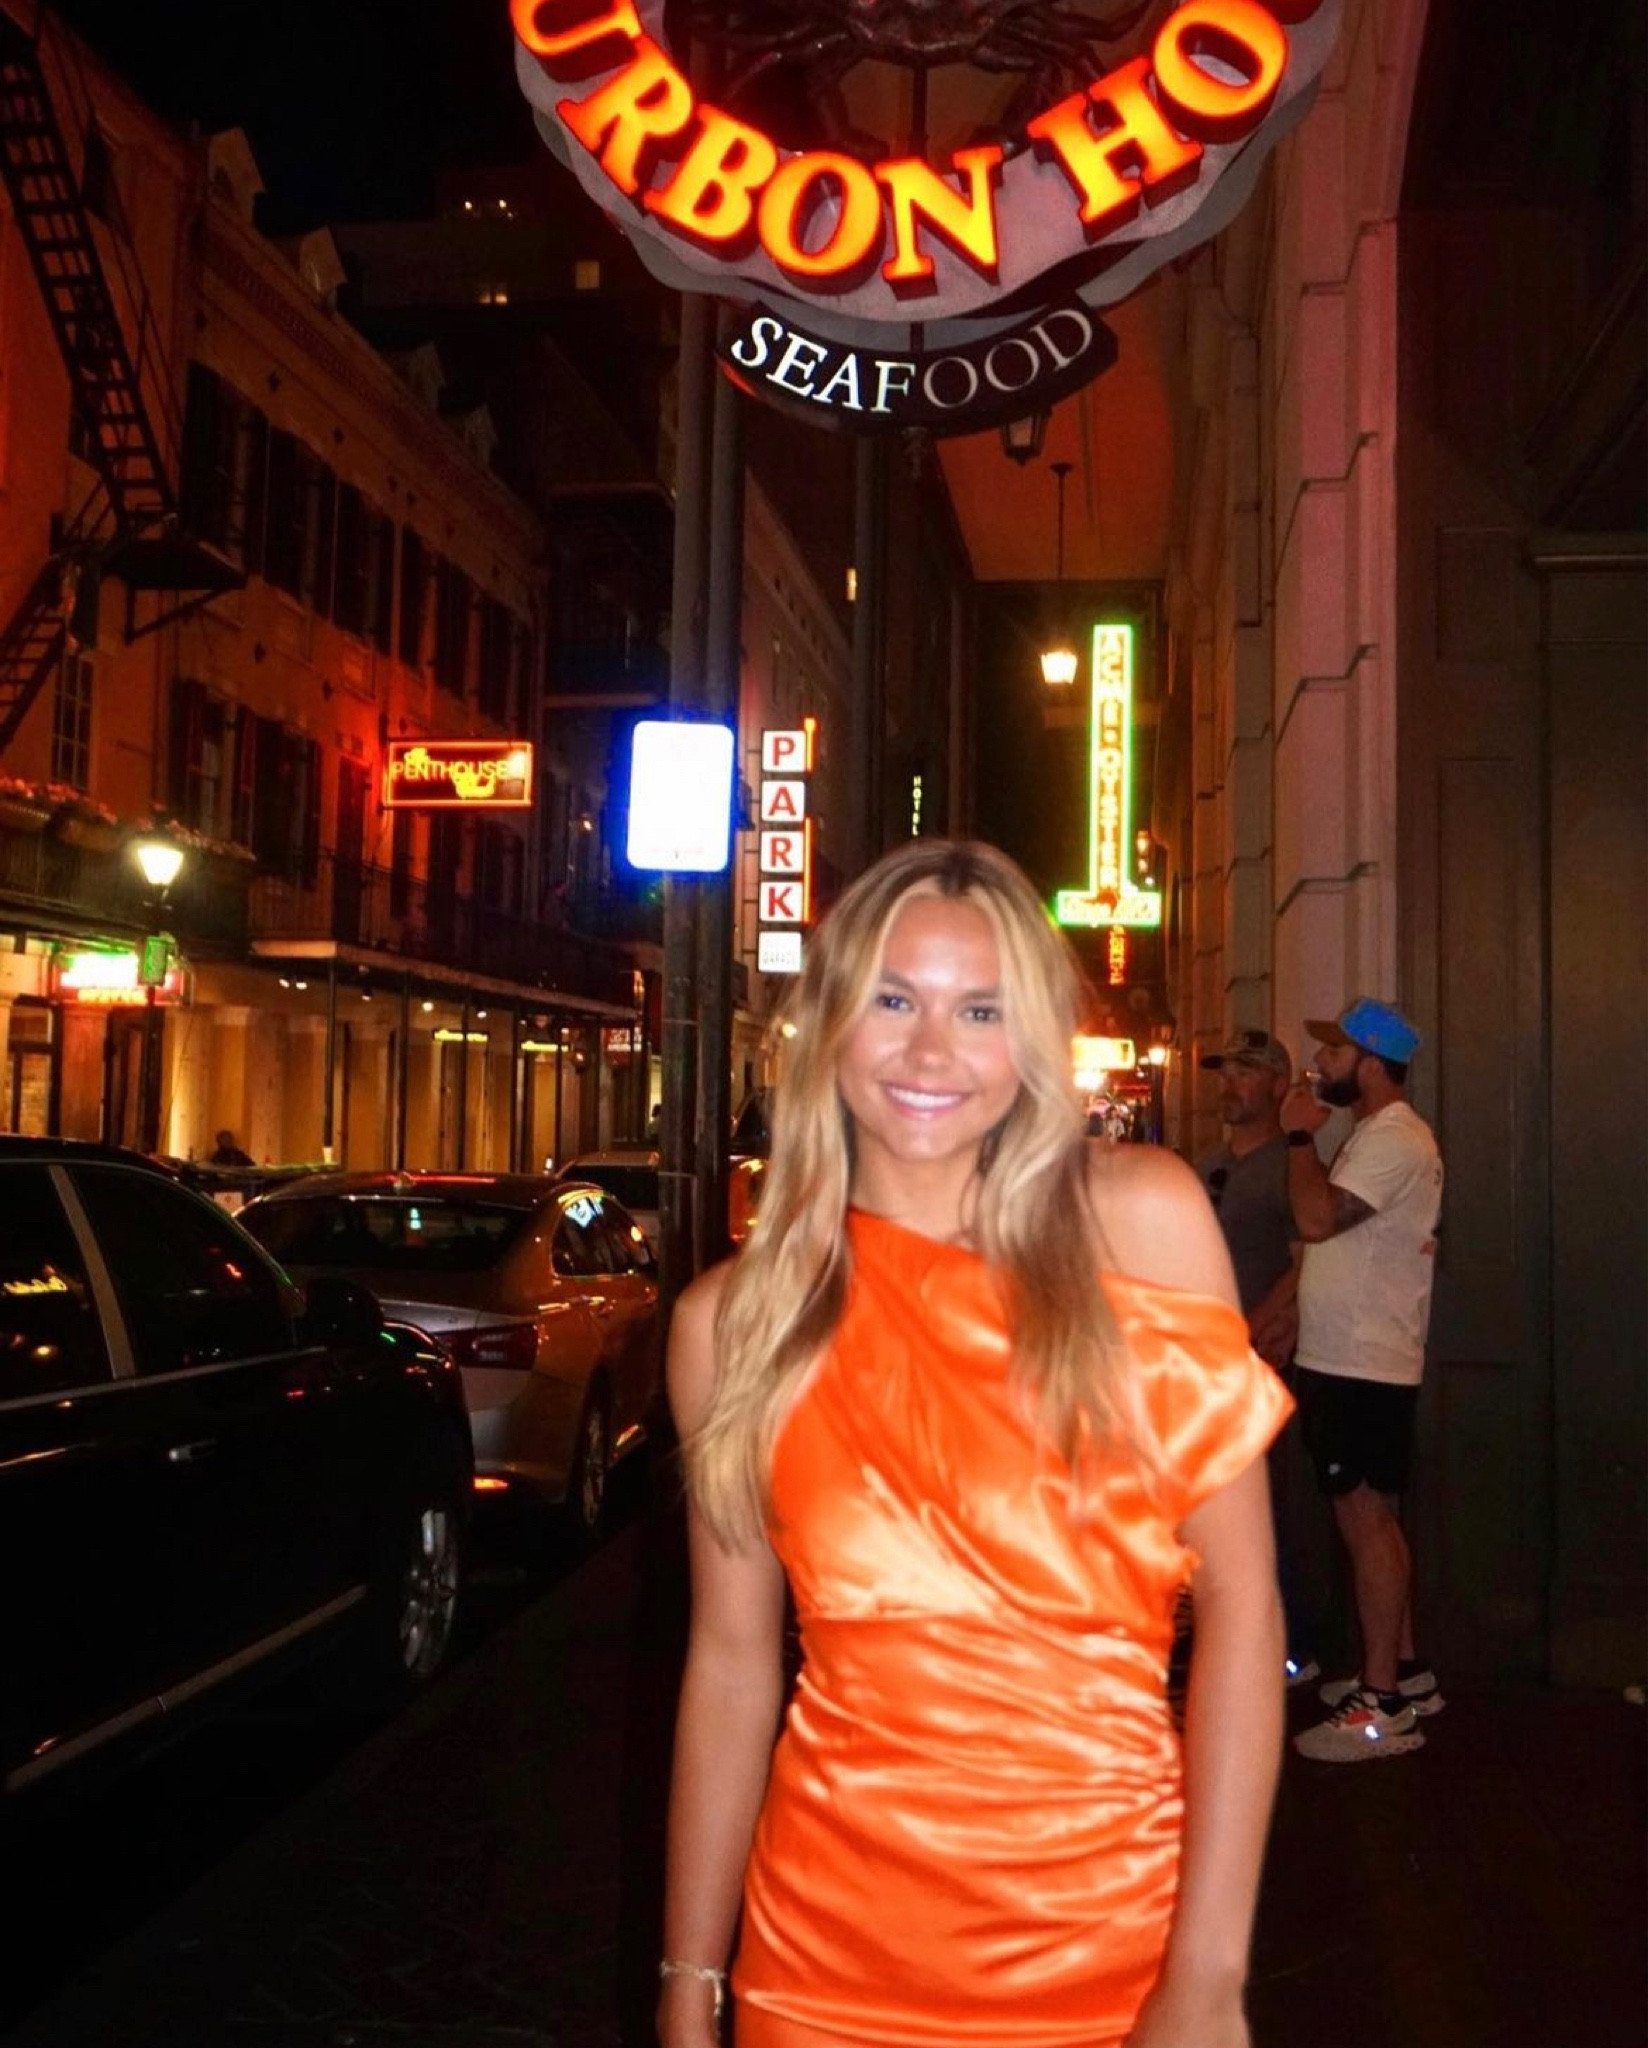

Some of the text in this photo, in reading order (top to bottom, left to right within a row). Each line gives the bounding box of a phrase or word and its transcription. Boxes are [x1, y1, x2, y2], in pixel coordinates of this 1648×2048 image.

[730, 308, 1094, 414] SEAFOOD
[390, 760, 508, 781] PENTHOUSE
[766, 736, 797, 918] PARK
